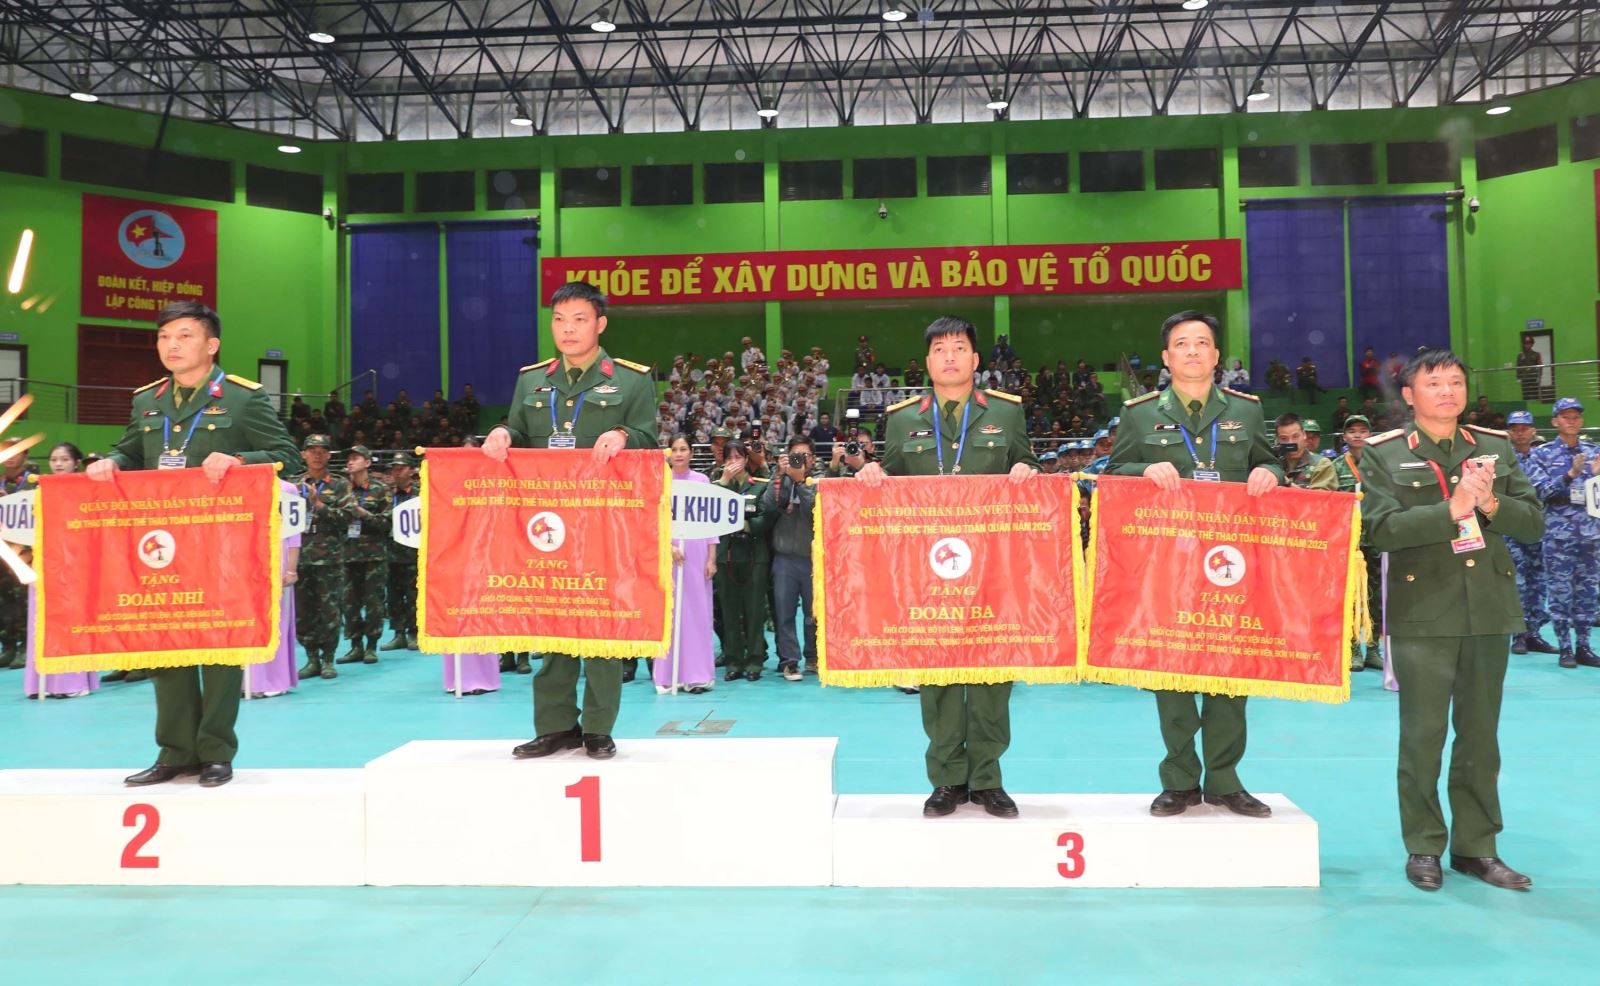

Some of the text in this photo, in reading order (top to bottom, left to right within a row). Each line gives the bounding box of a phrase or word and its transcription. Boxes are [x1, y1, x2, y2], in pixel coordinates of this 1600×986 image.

[660, 256, 704, 295] ĐỂ
[712, 260, 776, 293] XÂY
[787, 261, 877, 297] DỰNG
[888, 255, 930, 289] VÀ
[941, 251, 1008, 287] BẢO
[1018, 252, 1058, 291] VỆ
[1069, 246, 1111, 285] TỔ
[1121, 245, 1212, 287] QUỐC
[609, 480, 633, 490] NAM
[217, 496, 243, 506] NAM
[684, 496, 721, 523] KHU
[728, 498, 738, 524] 9
[1013, 503, 1040, 514] NAM
[289, 501, 299, 526] 5
[1290, 520, 1317, 531] NAM
[1307, 539, 1328, 550] 2025
[526, 557, 568, 571] TẶNG
[140, 573, 180, 587] TẶNG
[487, 570, 607, 590] ĐOÀN NHẤT
[117, 588, 204, 607] ĐOÀN NHÌ
[930, 583, 976, 599] TẶNG
[1200, 590, 1246, 606] TẶNG
[909, 602, 995, 620] ĐOÀN BA
[1177, 609, 1264, 630] ĐOÀN BA
[565, 776, 601, 862] 1
[120, 803, 161, 869] 2
[1056, 831, 1085, 879] 3
